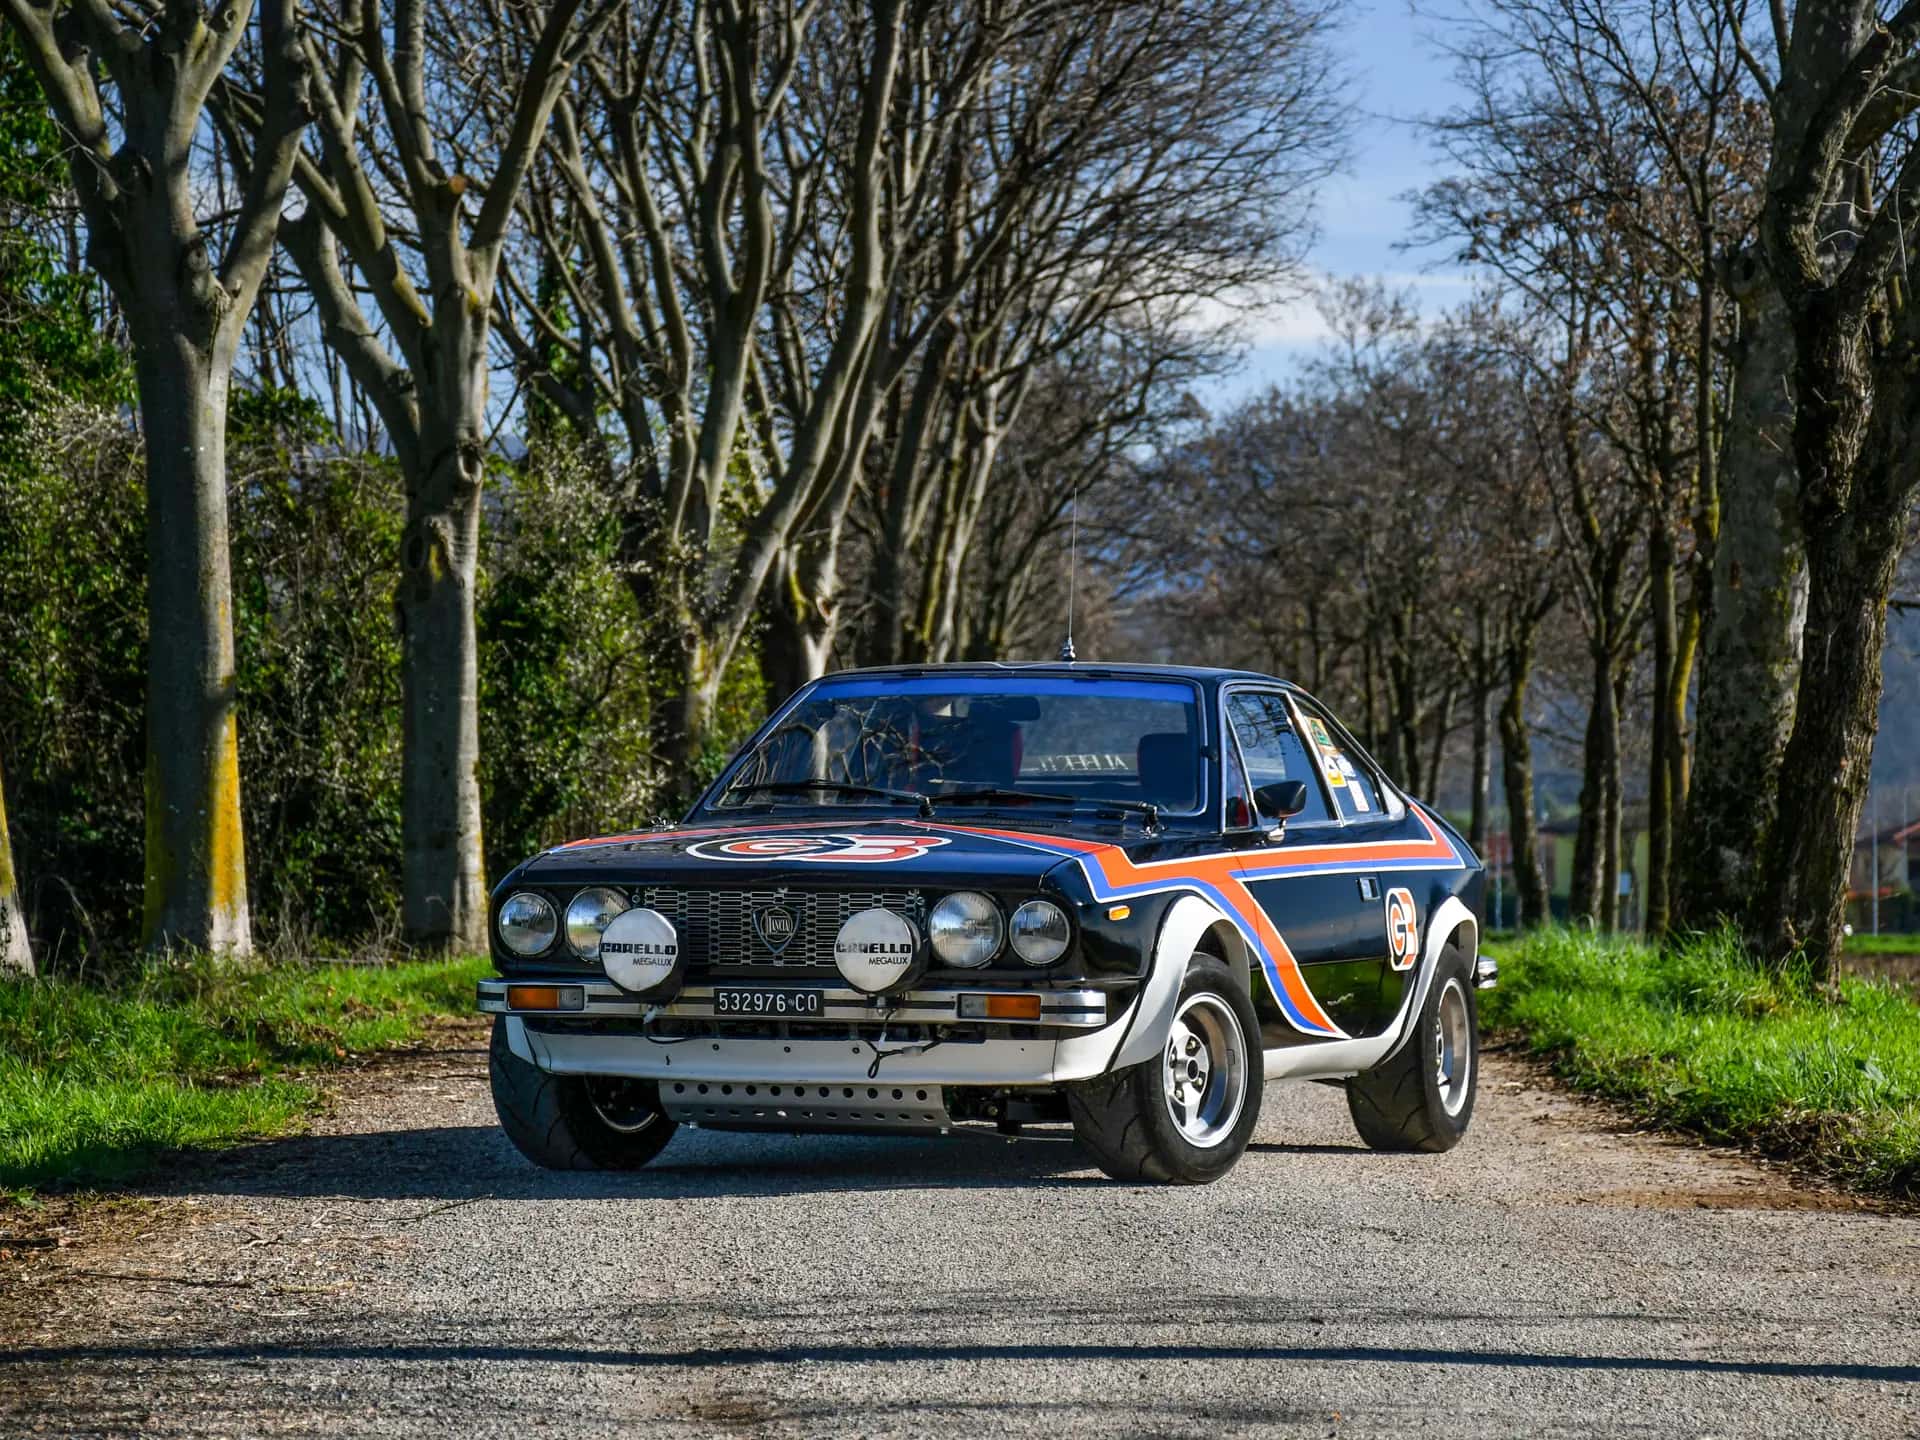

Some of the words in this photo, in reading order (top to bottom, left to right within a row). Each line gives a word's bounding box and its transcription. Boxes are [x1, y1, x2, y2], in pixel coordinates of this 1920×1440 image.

[632, 957, 672, 967] MEGALUX
[868, 956, 908, 965] MEGALUX
[719, 992, 787, 1012] 532976
[795, 993, 818, 1012] CO
